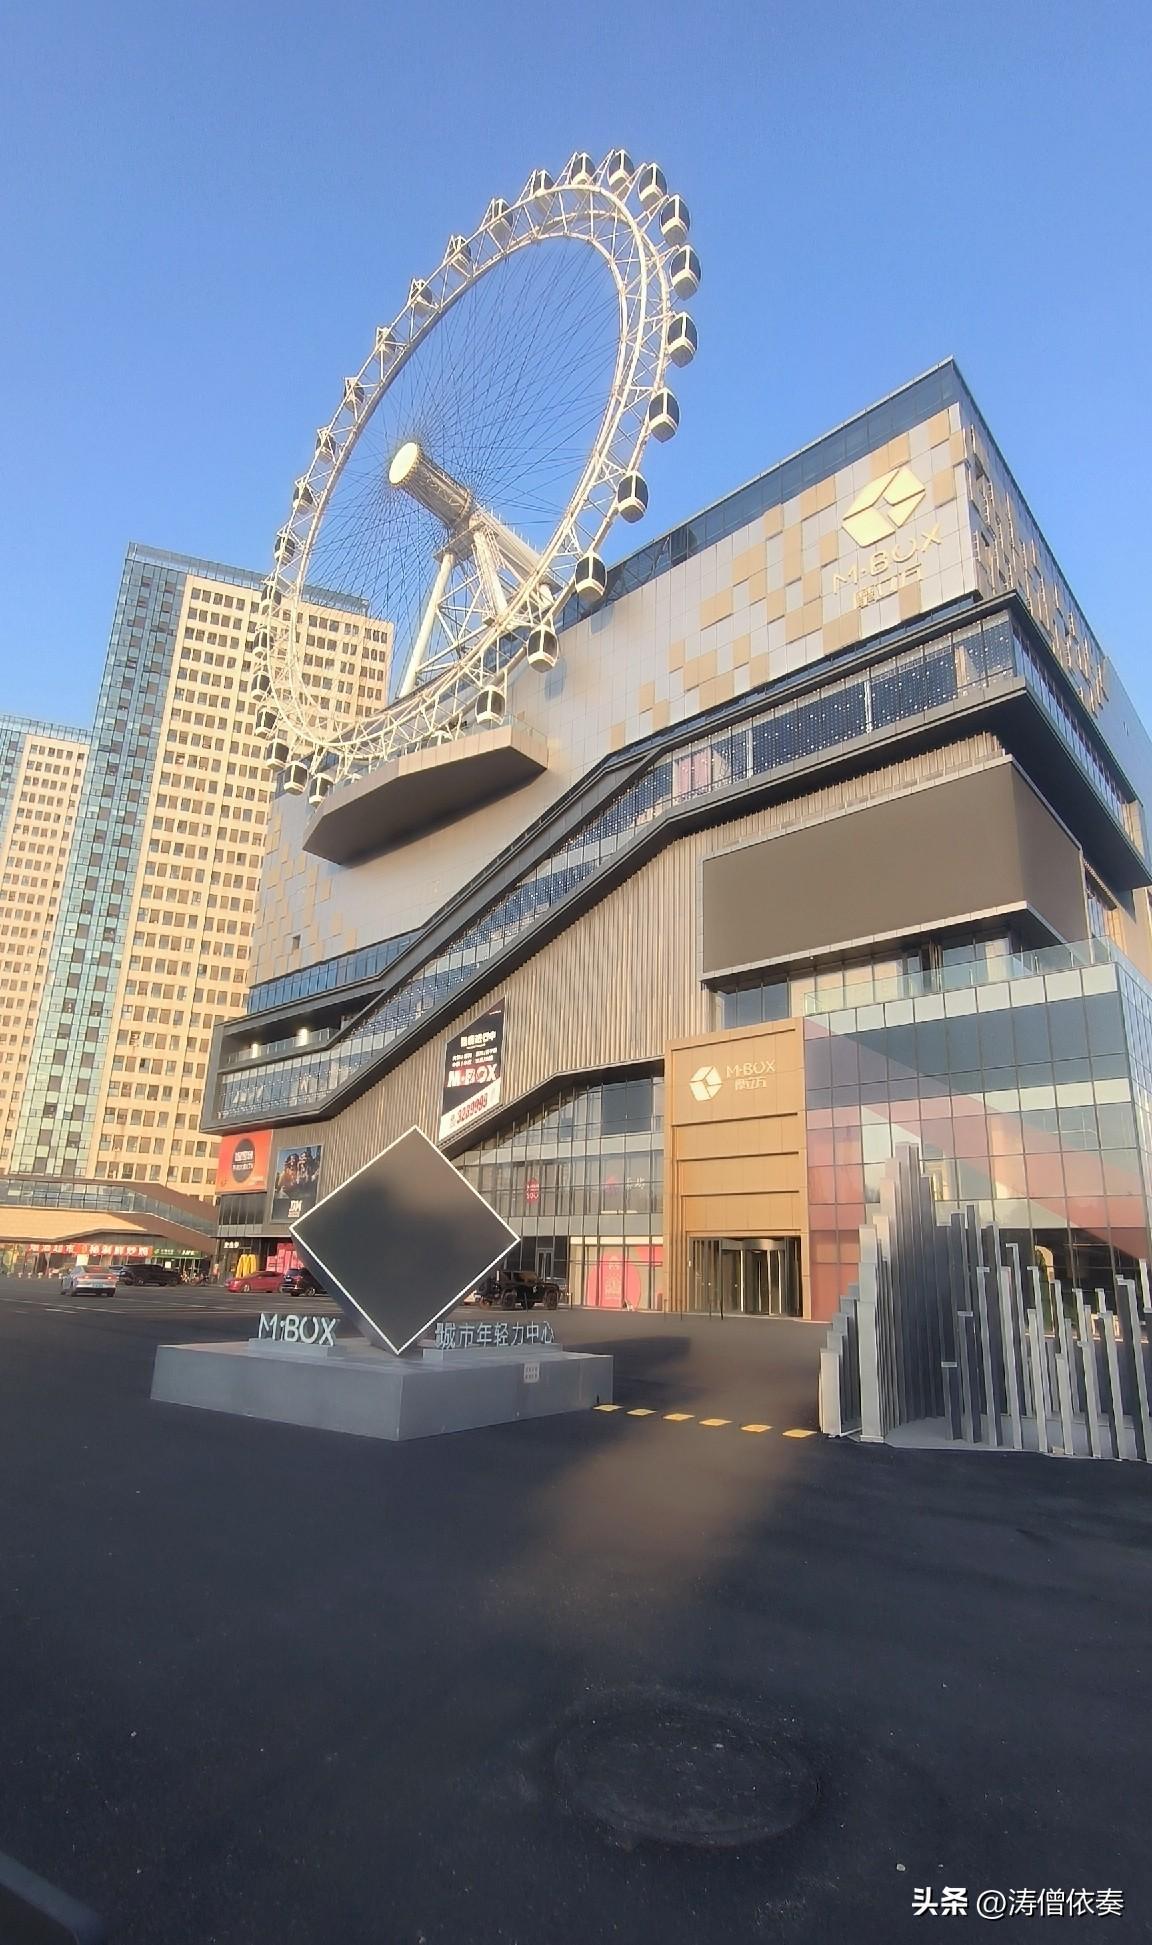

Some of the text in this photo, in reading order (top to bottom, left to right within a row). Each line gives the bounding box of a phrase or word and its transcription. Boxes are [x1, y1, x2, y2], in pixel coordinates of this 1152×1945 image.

[434, 1320, 555, 1350] 城市年轻力中心
